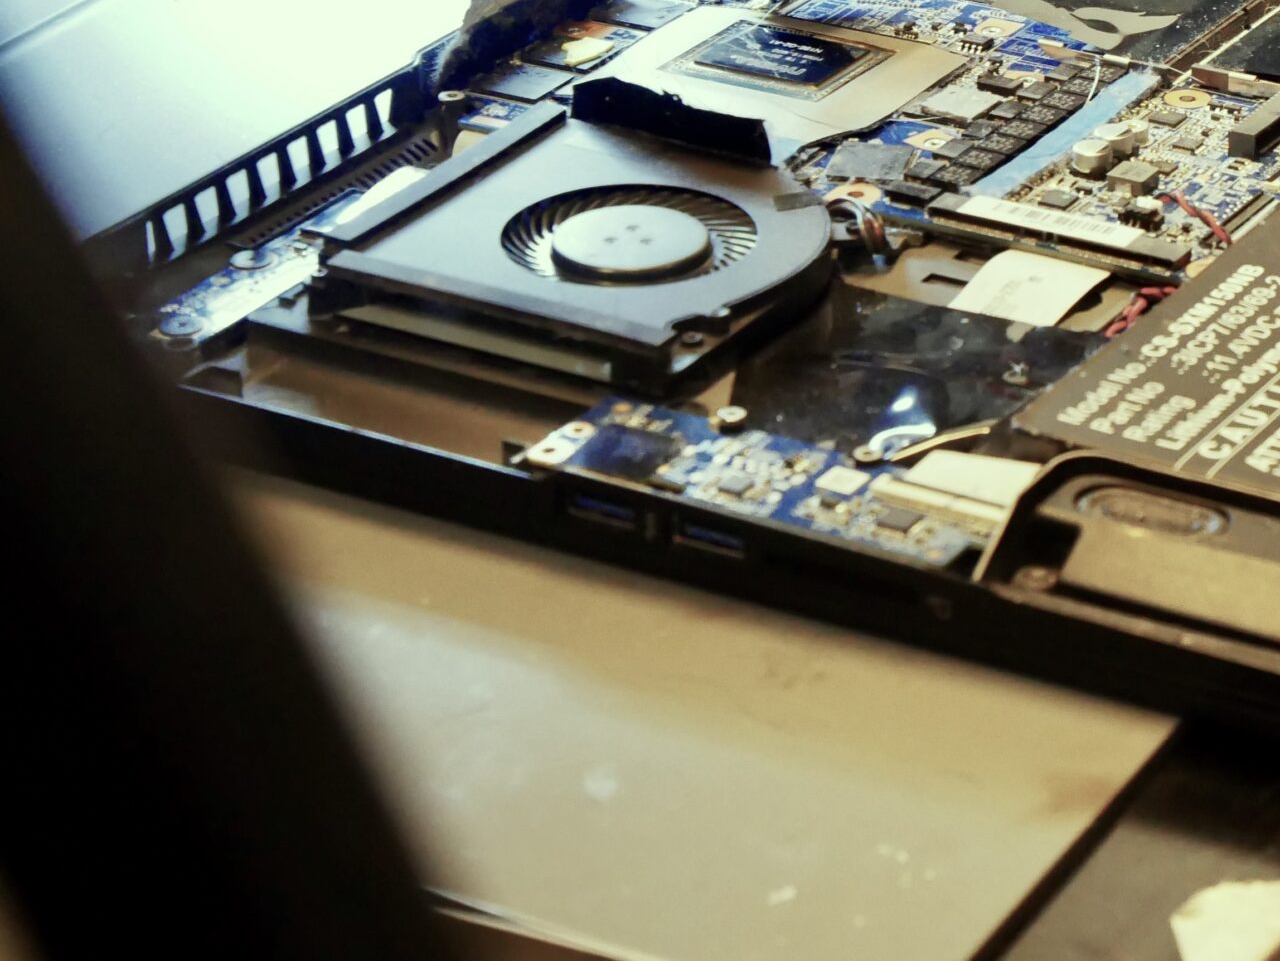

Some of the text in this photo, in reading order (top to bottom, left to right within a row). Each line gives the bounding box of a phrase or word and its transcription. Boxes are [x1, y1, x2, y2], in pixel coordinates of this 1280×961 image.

[1057, 380, 1122, 425] Model
[1089, 401, 1142, 434] Part
[1125, 382, 1165, 404] No
[1122, 395, 1196, 442] Rating
